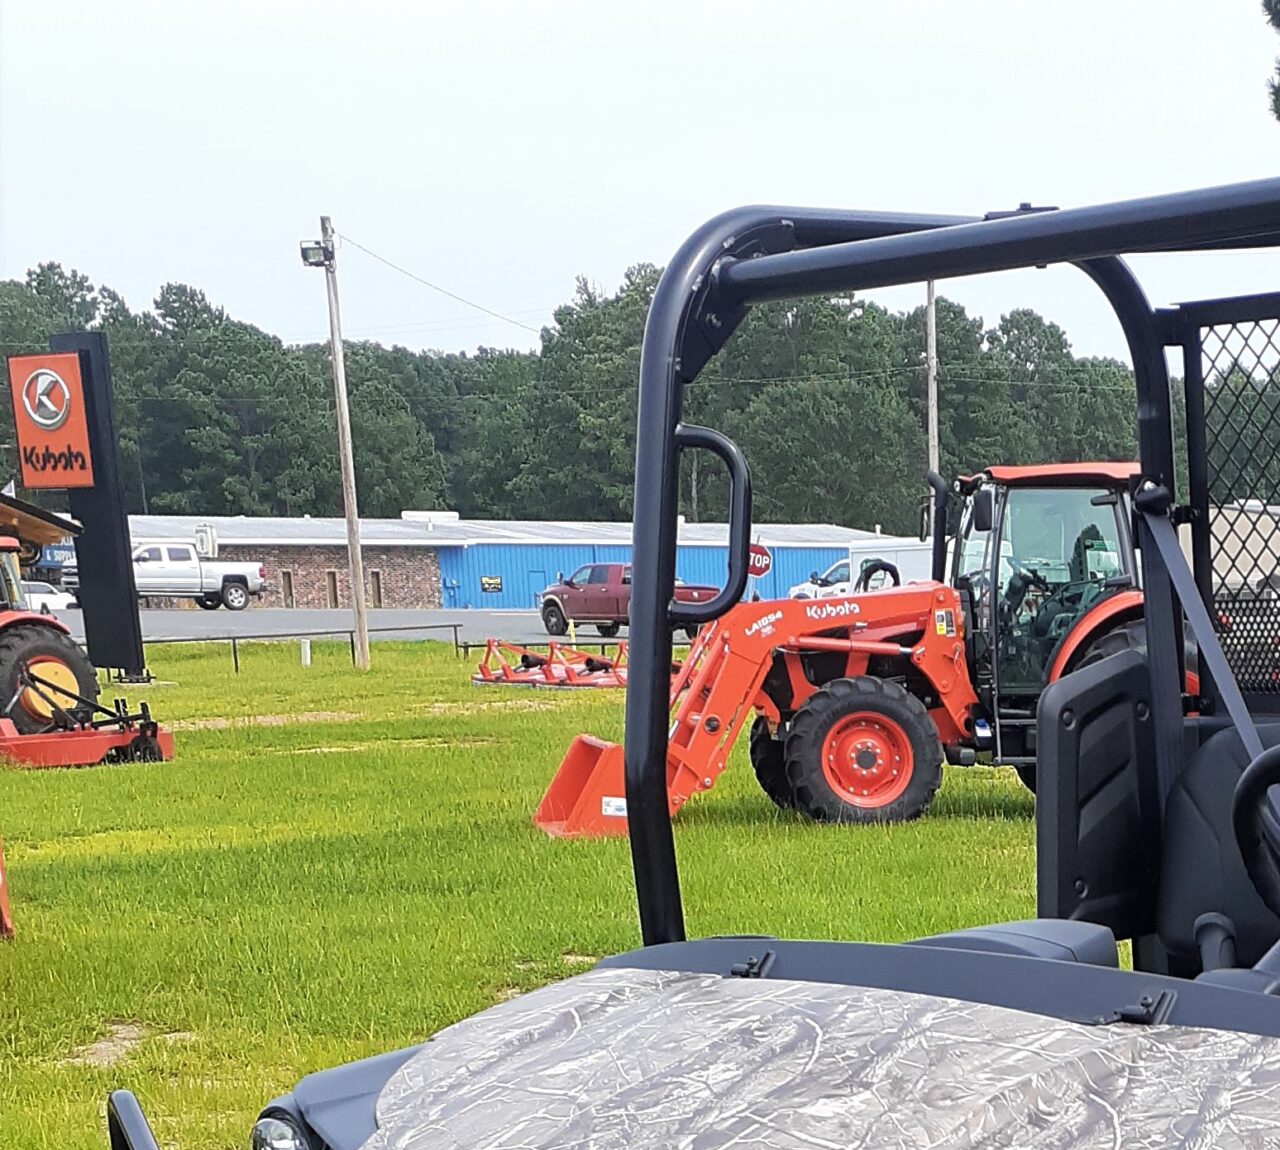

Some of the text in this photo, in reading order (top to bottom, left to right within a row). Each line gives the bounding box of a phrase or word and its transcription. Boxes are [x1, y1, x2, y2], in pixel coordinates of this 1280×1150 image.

[22, 443, 88, 472] Kubota
[750, 552, 771, 568] TOP
[806, 600, 861, 619] Kubota
